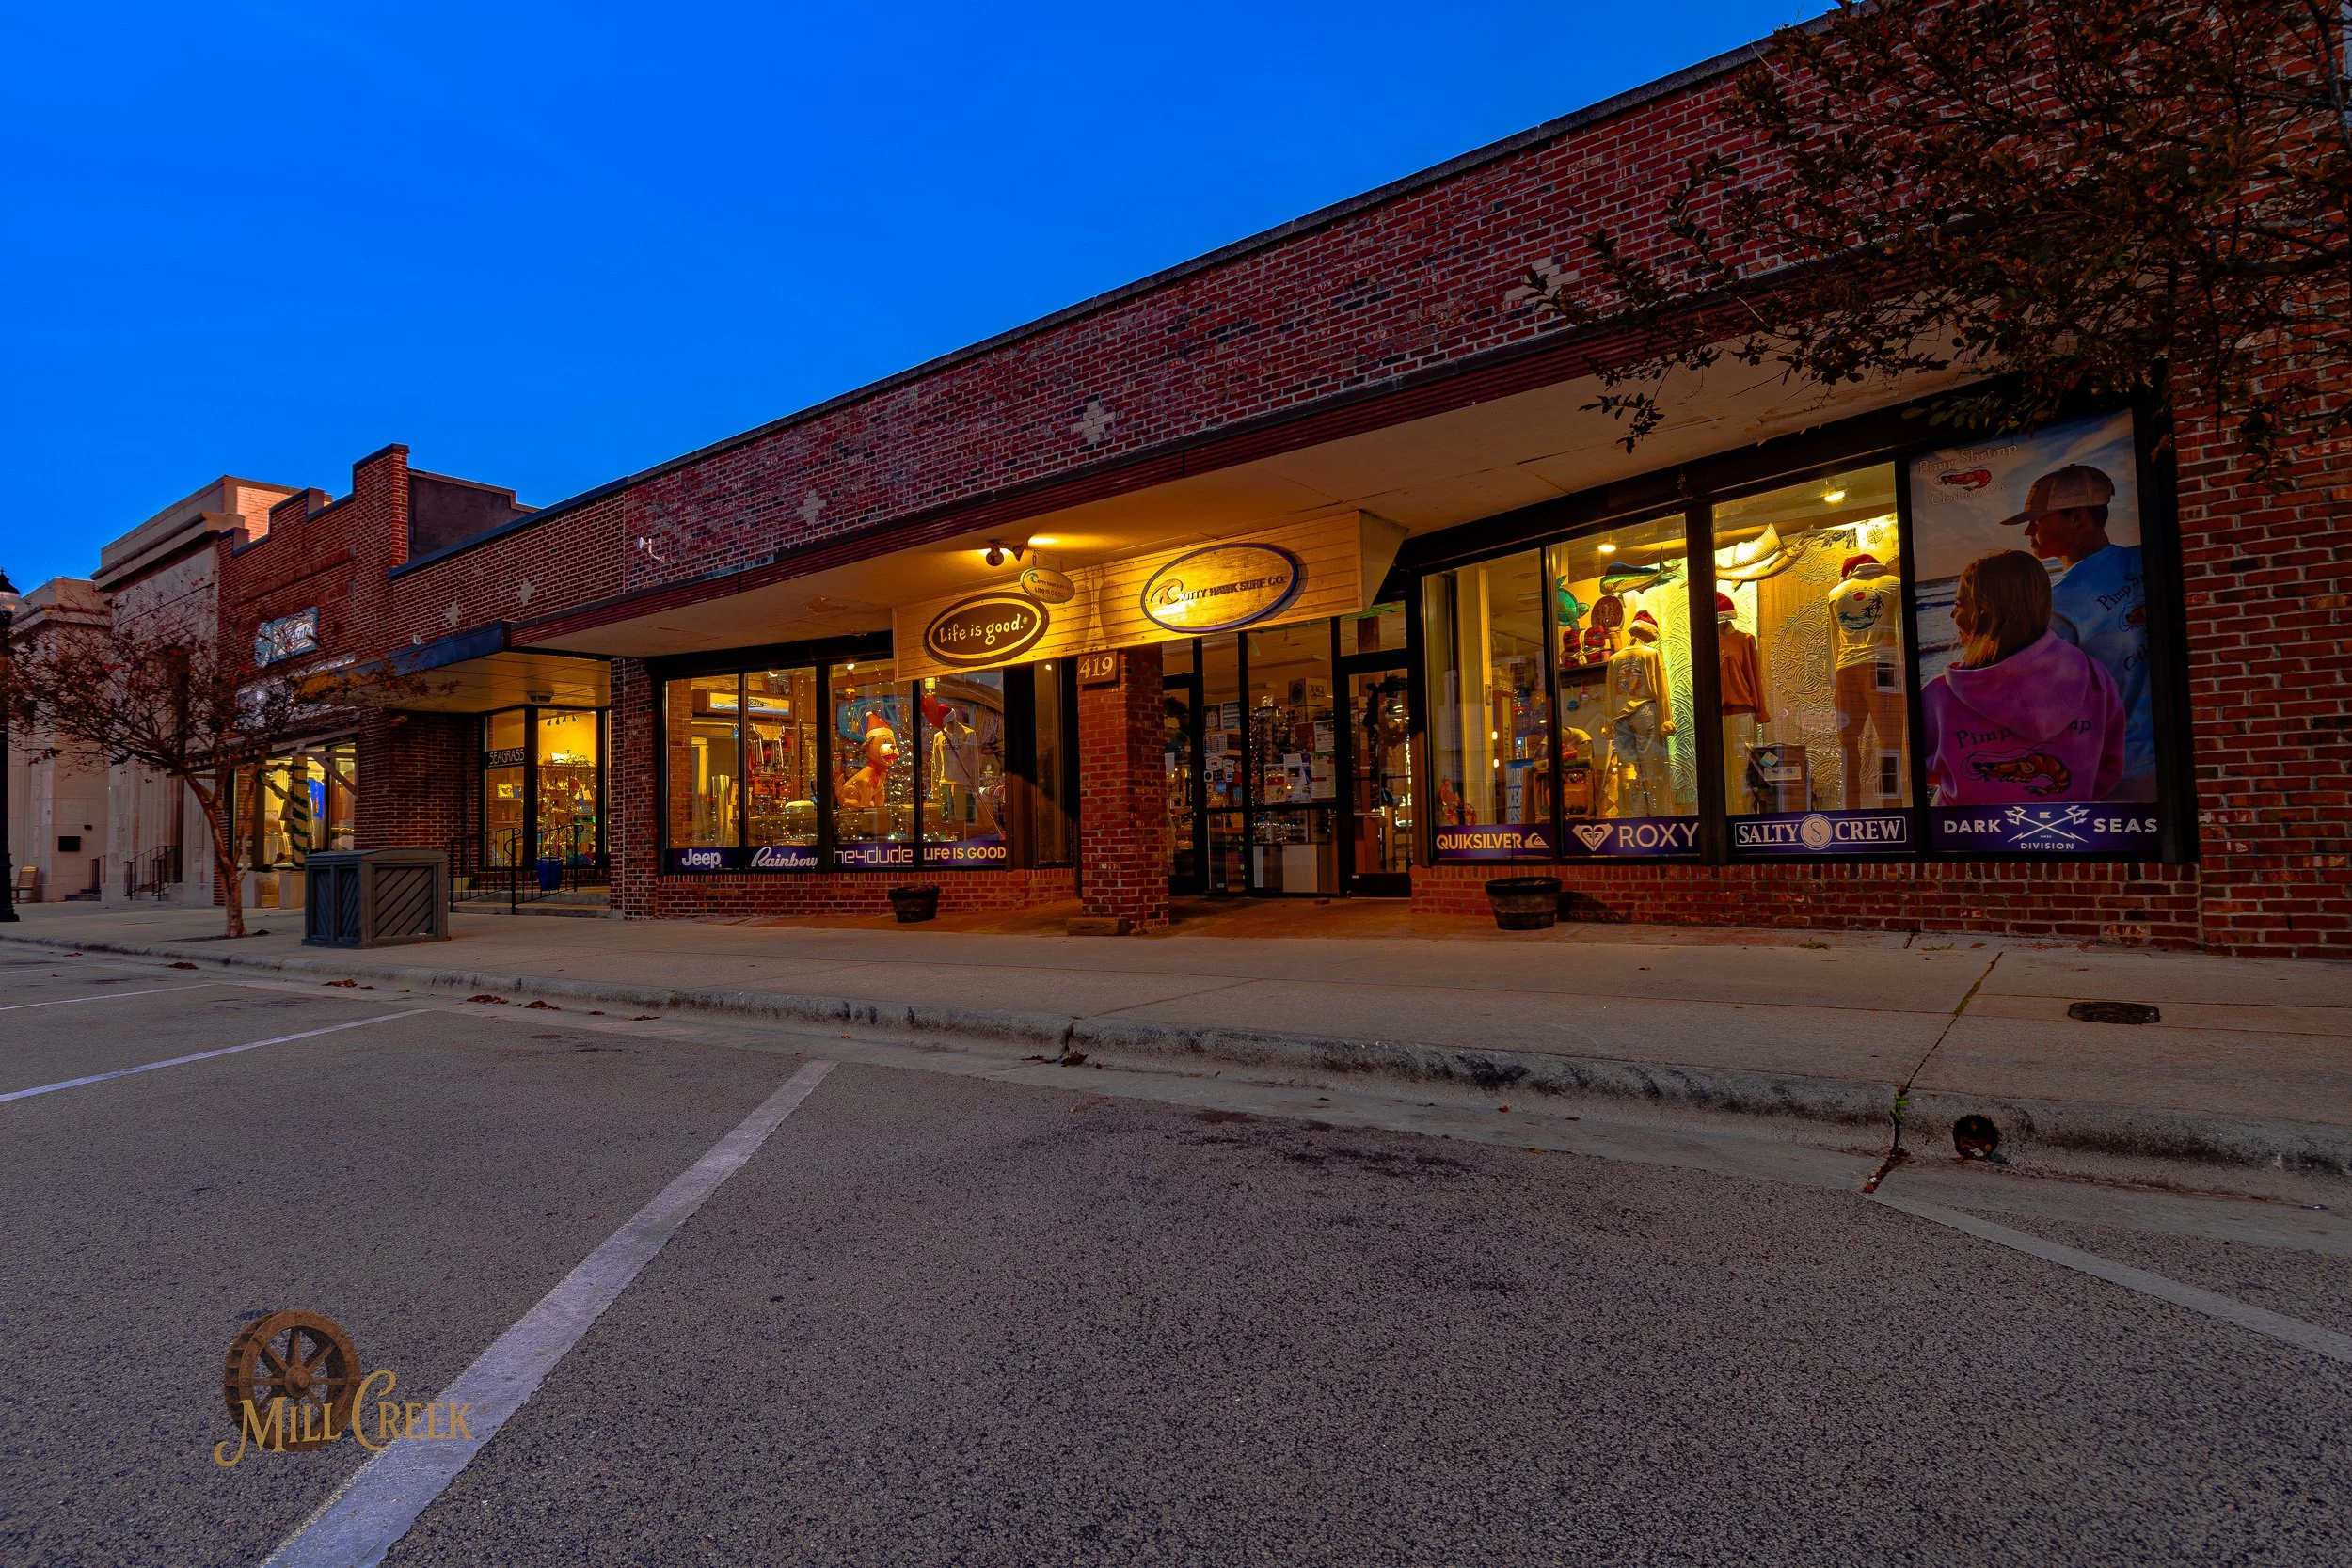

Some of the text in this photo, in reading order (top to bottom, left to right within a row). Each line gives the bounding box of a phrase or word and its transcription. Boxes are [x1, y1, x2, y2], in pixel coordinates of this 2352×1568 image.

[1919, 445, 2017, 474] Pimp Shrimp
[1931, 486, 1984, 505] Clothing
[1180, 588, 1208, 602] KITTY
[1209, 582, 1238, 596] HAWK
[1239, 578, 1265, 592] SURF
[2096, 585, 2131, 611] Pimp
[939, 623, 967, 644] Life
[970, 624, 982, 637] is
[1079, 657, 1113, 678] 419
[1956, 726, 2013, 749] Pimp
[489, 749, 524, 765] SEAGRASS
[1618, 822, 1699, 847] ROXY
[1739, 823, 1799, 844] SALTY
[1835, 819, 1900, 840] CREW
[1944, 818, 2158, 833] DARK SEAS
[1437, 832, 1522, 850] QUIKSILVER
[2020, 842, 2074, 850] DIVISION
[751, 847, 818, 867] Rainbow
[953, 847, 964, 860] IS
[967, 847, 1007, 860] GOOD
